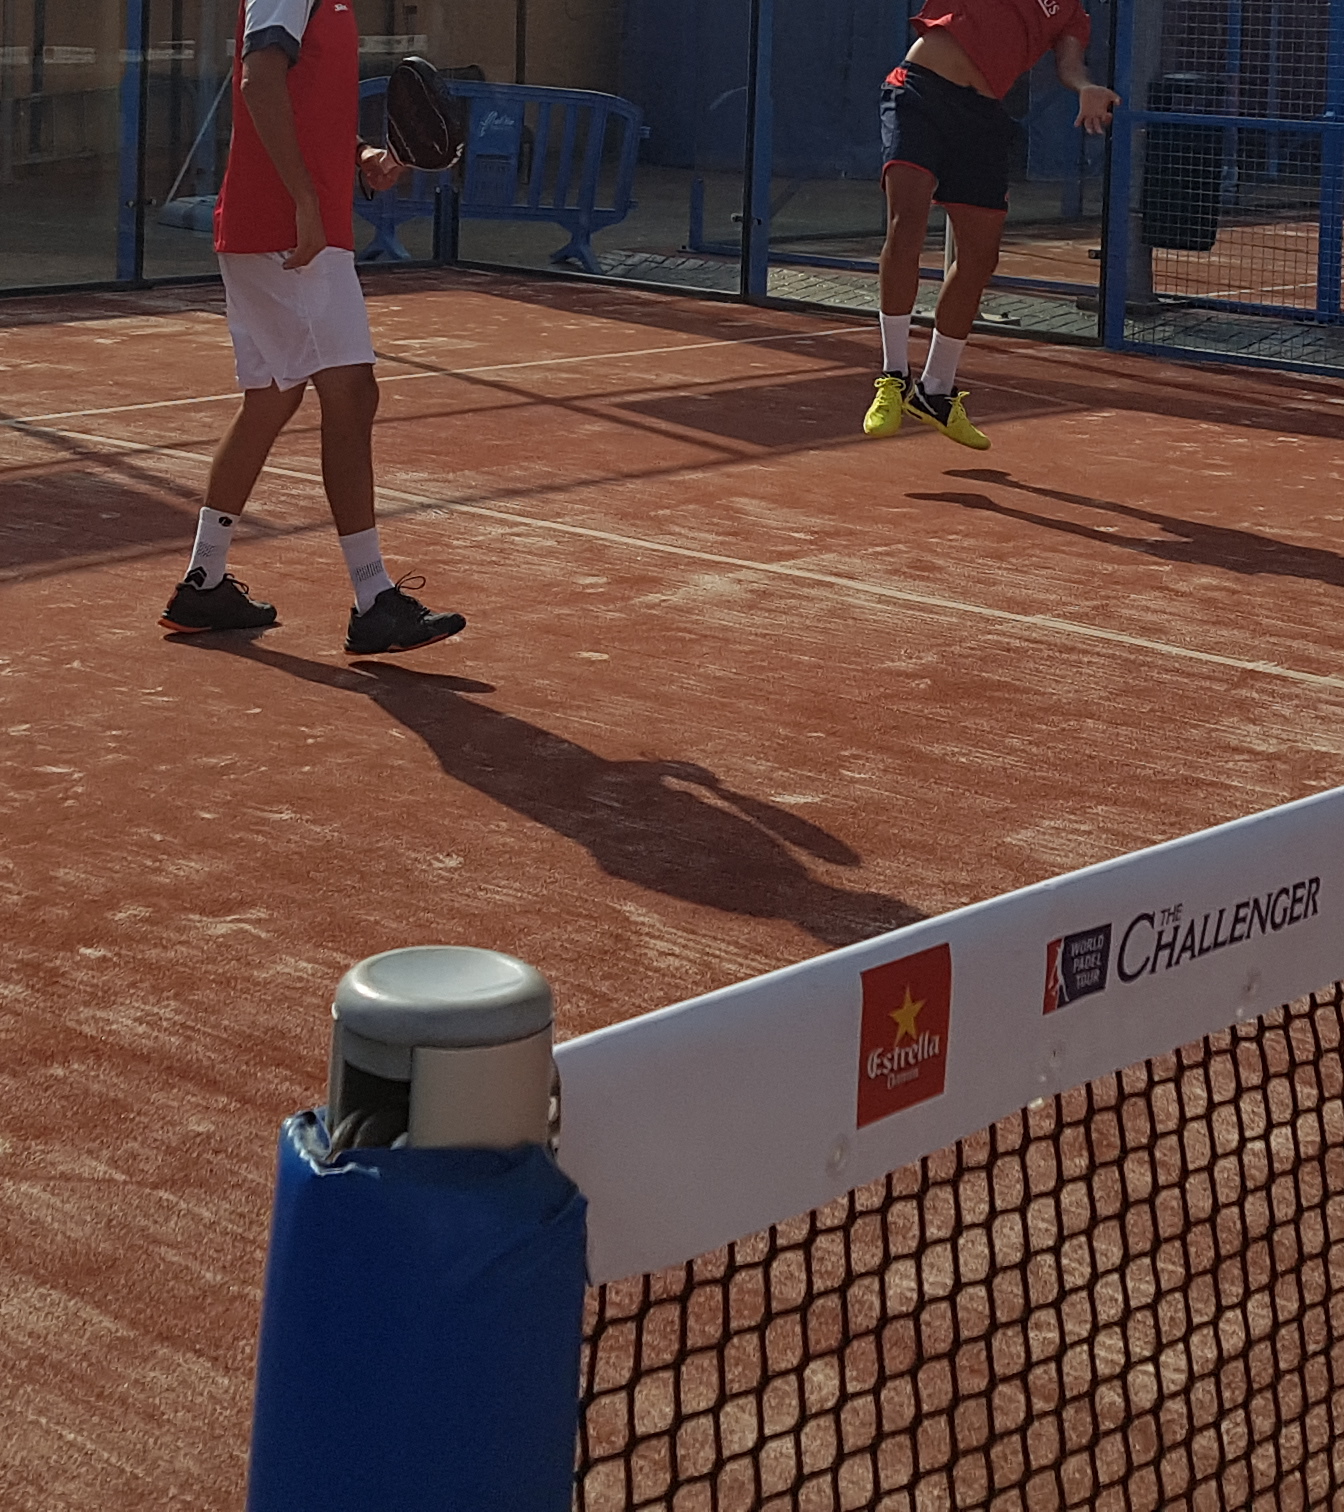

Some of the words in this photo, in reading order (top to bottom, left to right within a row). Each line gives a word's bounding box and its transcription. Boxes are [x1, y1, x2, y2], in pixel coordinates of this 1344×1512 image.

[1161, 902, 1183, 927] THE
[1117, 876, 1321, 984] CHALLENGER
[1071, 934, 1105, 957] WORLD
[1073, 951, 1102, 974] PADEL
[867, 1029, 941, 1080] Estrella
